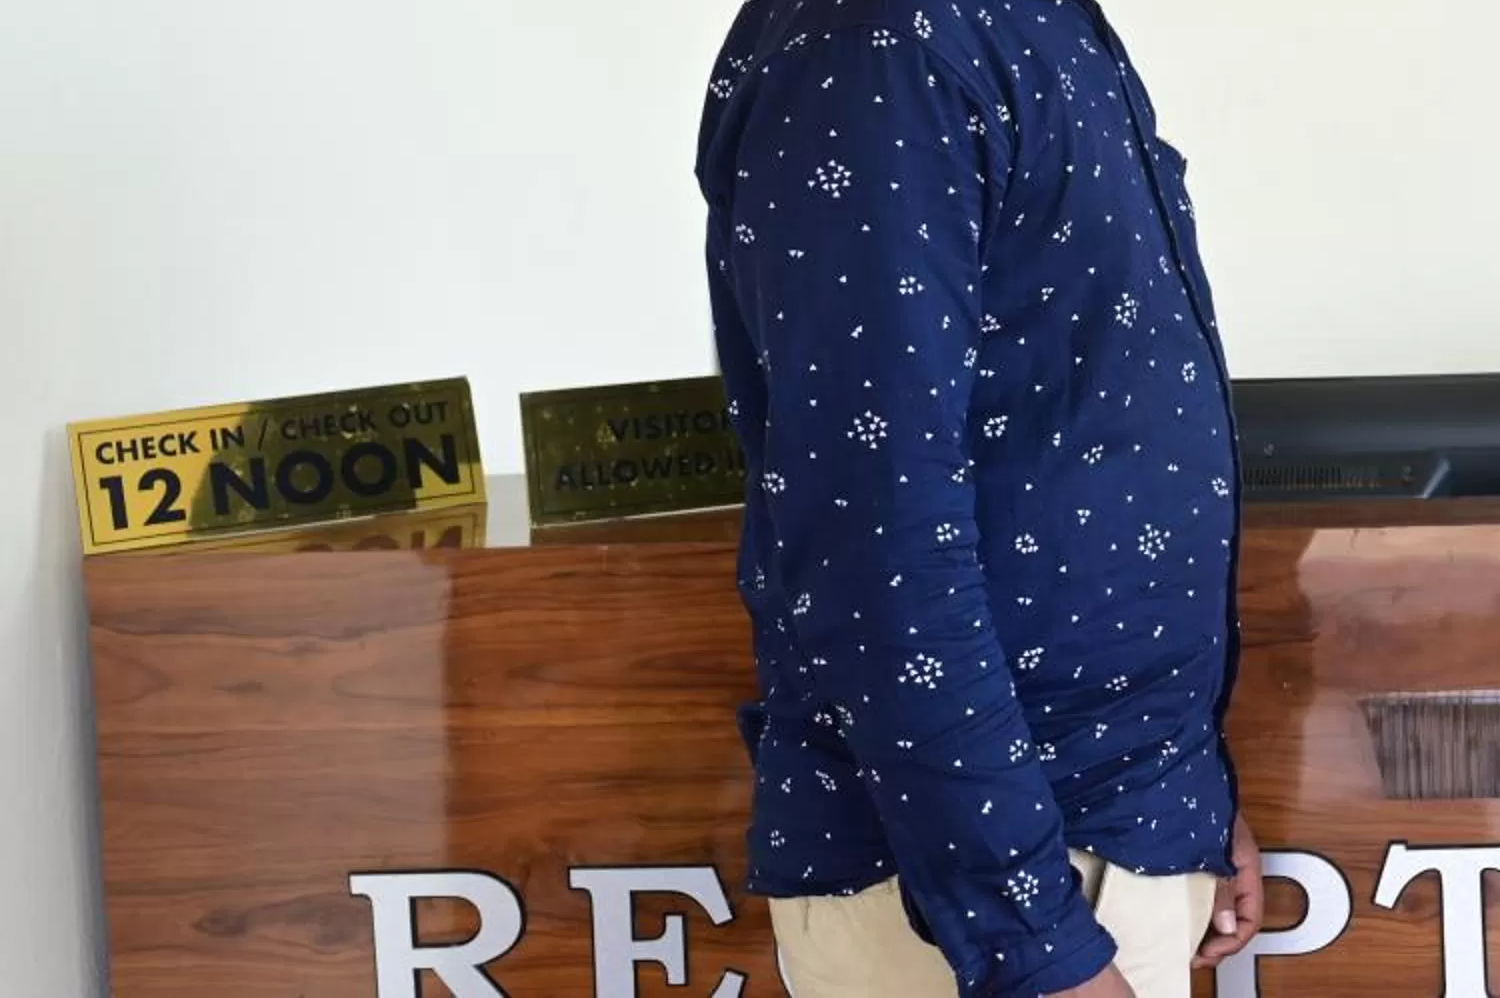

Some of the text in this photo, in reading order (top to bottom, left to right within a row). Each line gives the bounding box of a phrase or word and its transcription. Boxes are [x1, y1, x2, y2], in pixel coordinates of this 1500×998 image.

[95, 401, 449, 465] CHECK IN / CHECK OUT
[98, 433, 460, 531] 12 NOON
[556, 452, 714, 491] ALLOWED
